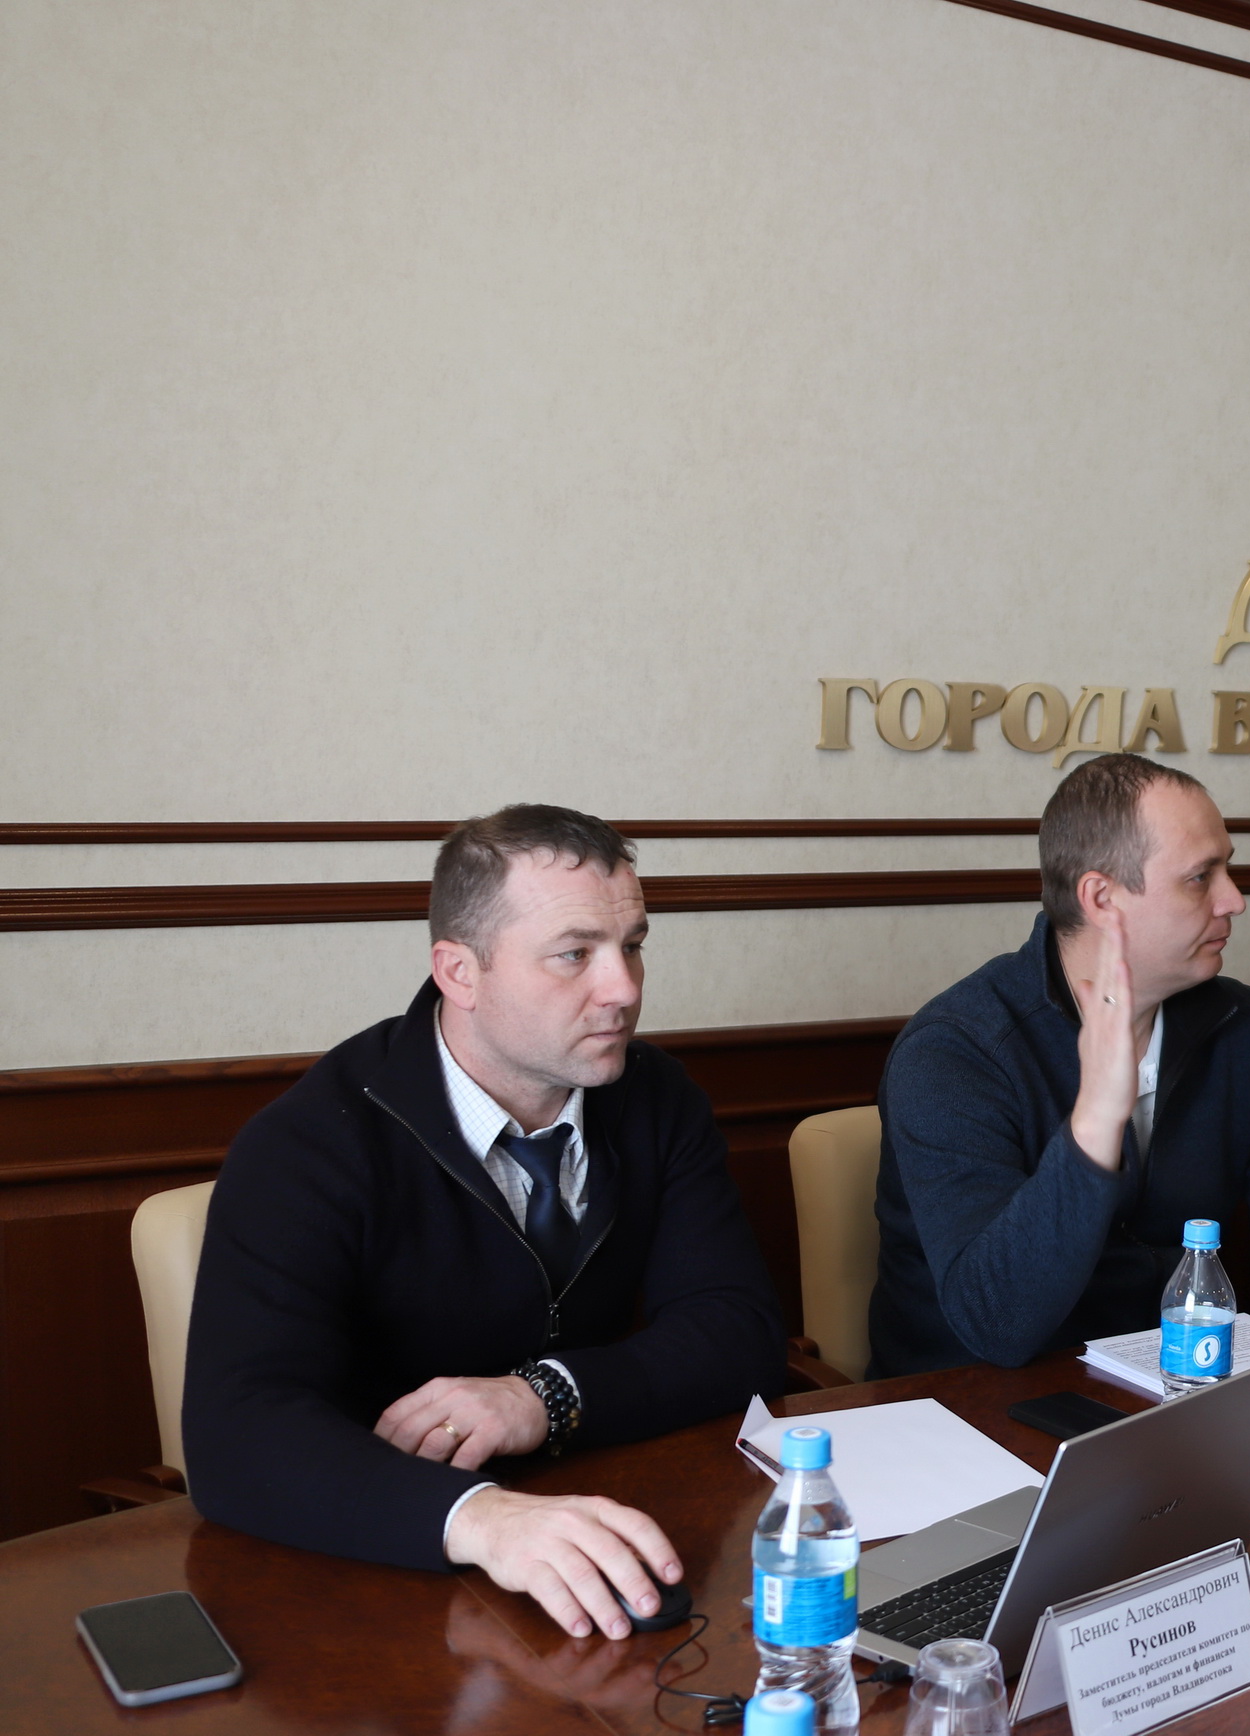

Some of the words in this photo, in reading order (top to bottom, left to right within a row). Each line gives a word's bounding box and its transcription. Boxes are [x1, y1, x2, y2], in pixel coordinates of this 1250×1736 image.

[815, 676, 1188, 768] ГОРОДА
[1070, 1616, 1120, 1651] Денис
[1125, 1571, 1241, 1627] Александрович
[1129, 1620, 1197, 1658] Русинов
[1077, 1670, 1137, 1700] Заместитель
[1139, 1646, 1197, 1678] председателя
[1199, 1629, 1239, 1652] комитета
[1240, 1622, 1250, 1635] по
[1101, 1684, 1145, 1708] бюджету,
[1146, 1669, 1183, 1690] налогам
[1192, 1645, 1236, 1672] финансам
[1112, 1704, 1139, 1724] Думы
[1141, 1690, 1171, 1712] города
[1172, 1664, 1233, 1697] Владивостока
